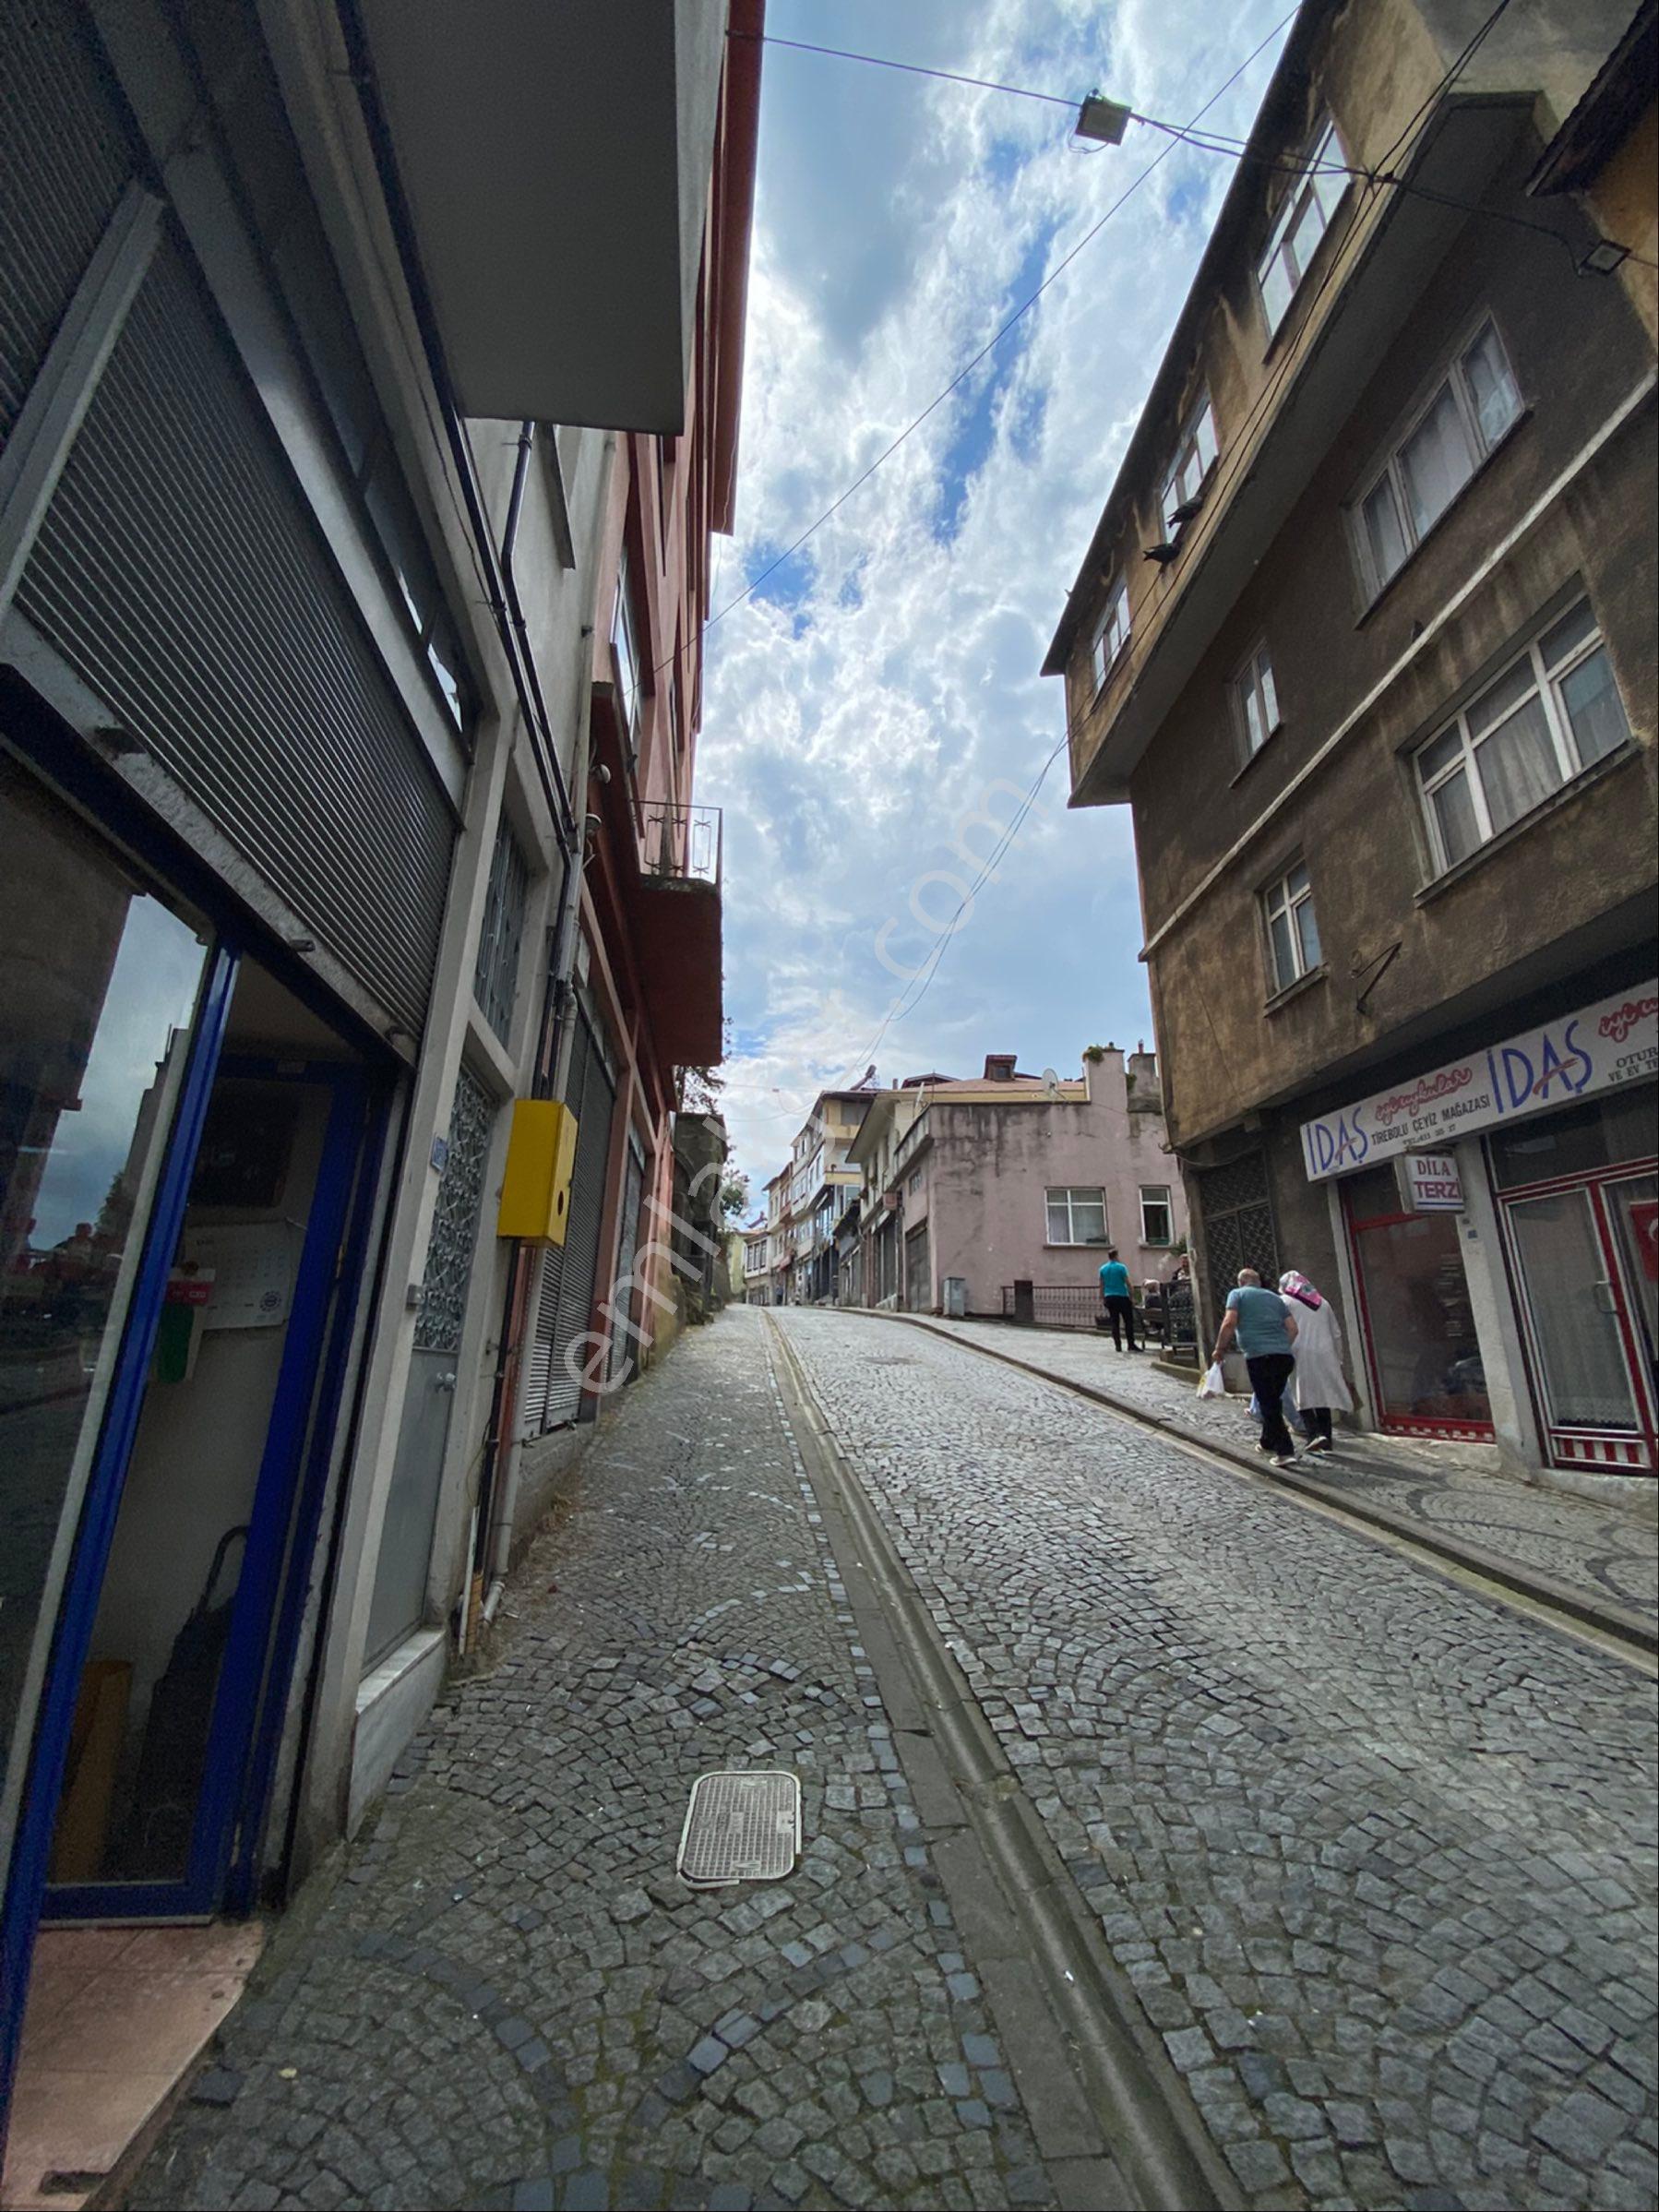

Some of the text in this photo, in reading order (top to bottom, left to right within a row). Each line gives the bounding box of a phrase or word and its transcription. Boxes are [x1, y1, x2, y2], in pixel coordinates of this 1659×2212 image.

[1486, 1020, 1593, 1114] İDAŞ
[1608, 1071, 1624, 1082] VE
[1626, 1065, 1640, 1077] EV
[1371, 1094, 1492, 1146] TİREBOLU ÇEYİZ MAĞAZASI
[1305, 1107, 1370, 1175] İDAŞ
[1416, 1157, 1451, 1177] DİLA
[1414, 1178, 1462, 1200] TERZİ
